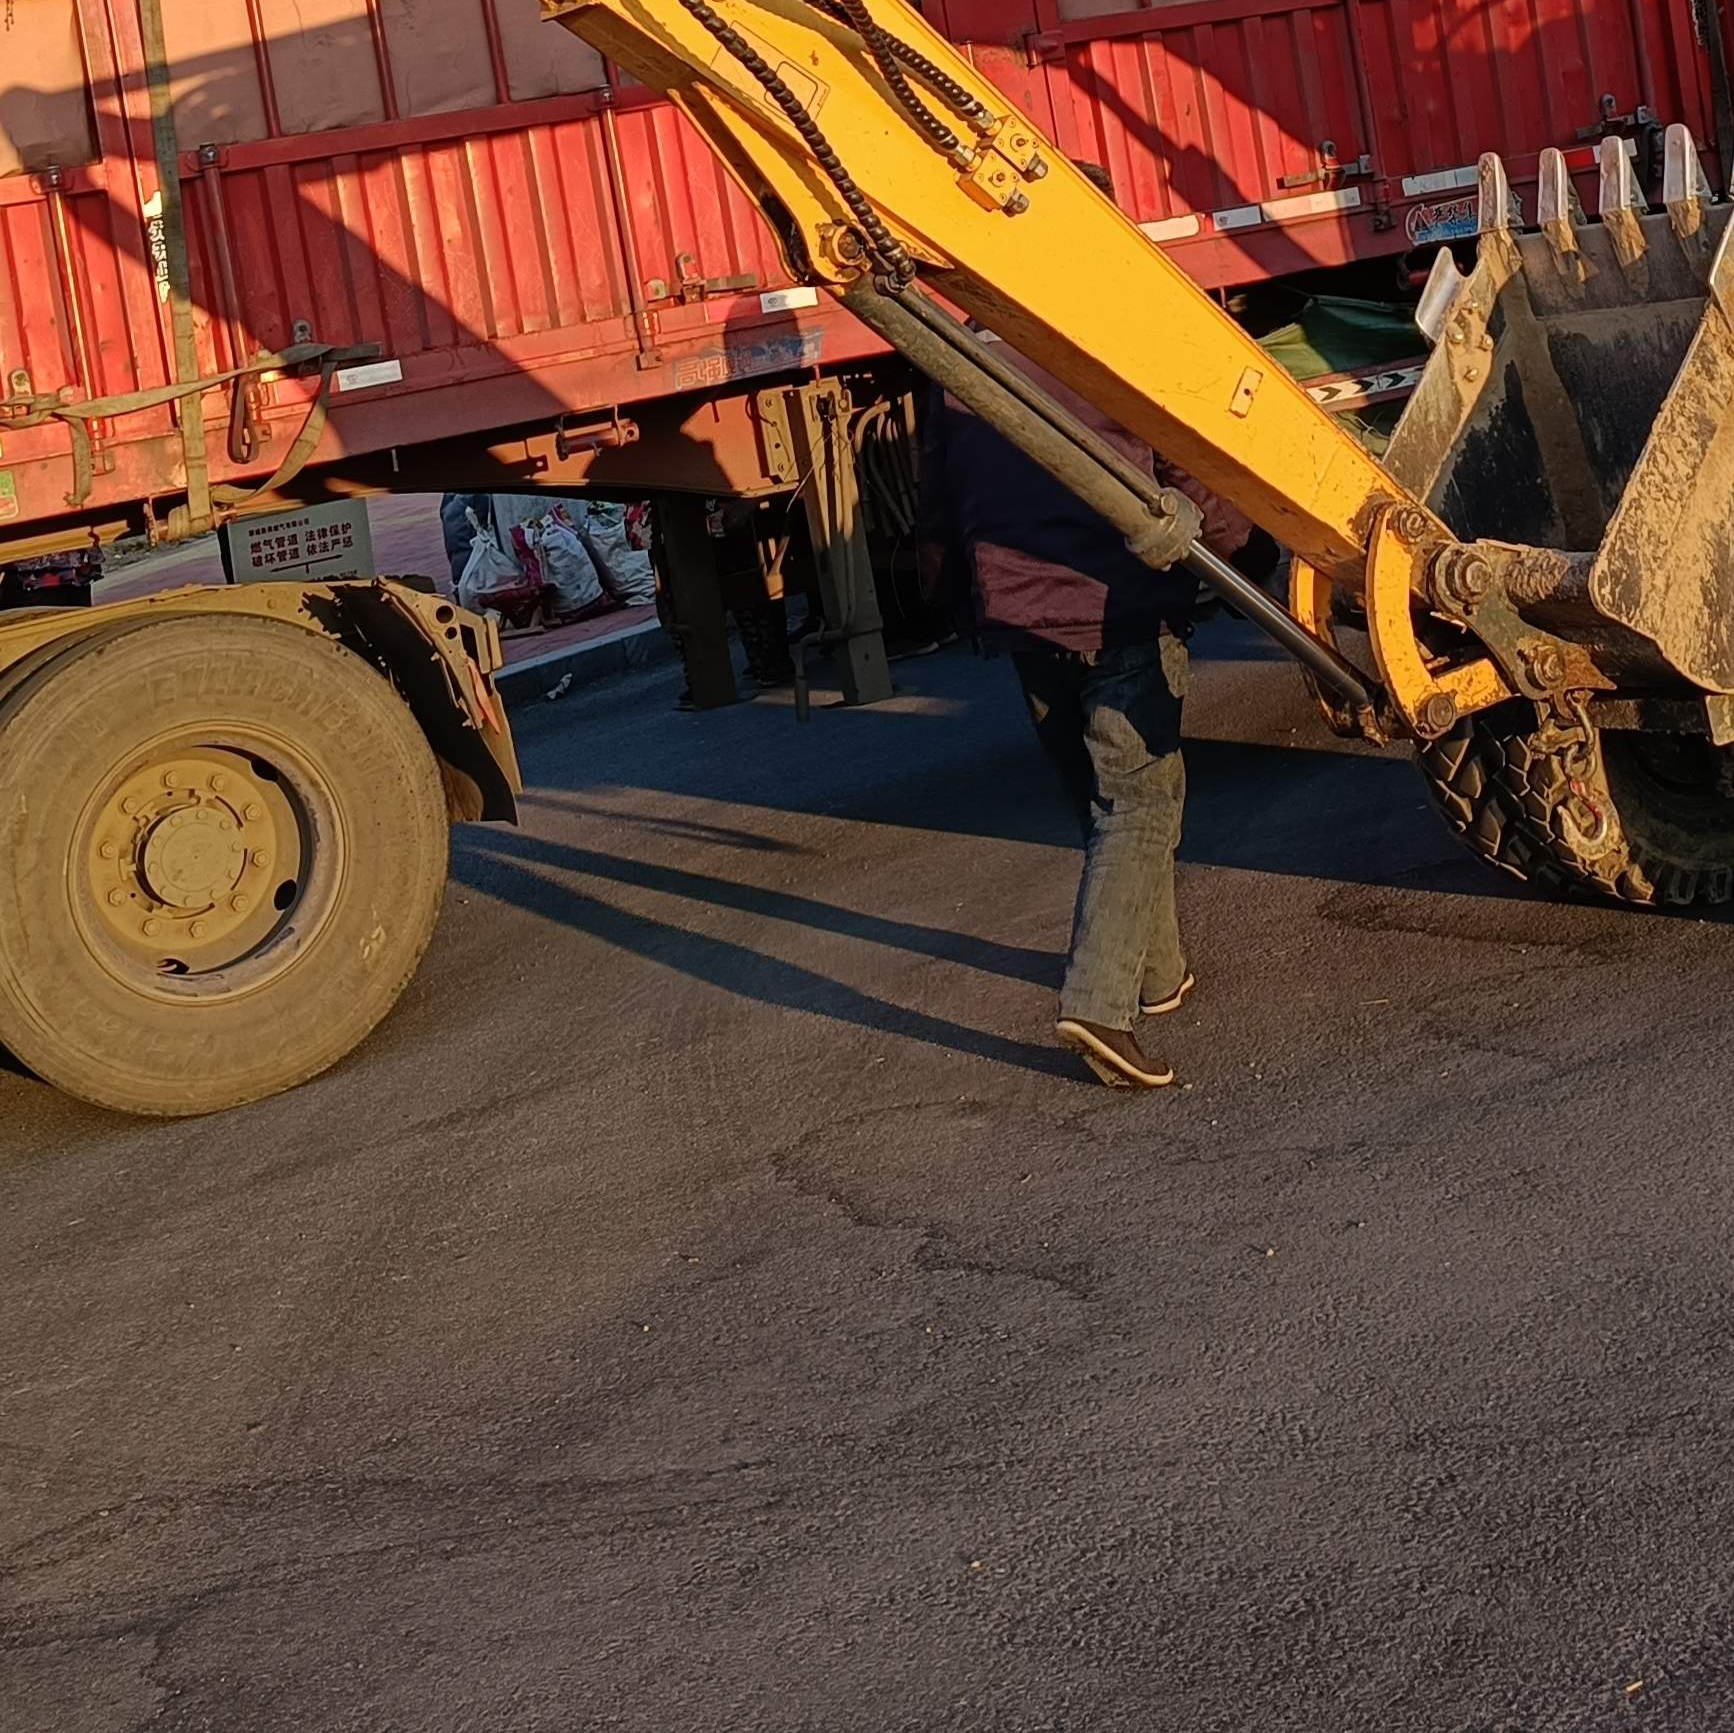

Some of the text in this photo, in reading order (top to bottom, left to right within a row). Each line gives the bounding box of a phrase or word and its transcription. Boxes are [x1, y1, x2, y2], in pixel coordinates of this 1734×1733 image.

[250, 533, 298, 555] 燃气管道
[304, 522, 352, 543] 法律保护
[252, 535, 354, 567] 破坏管道 依法严惩
